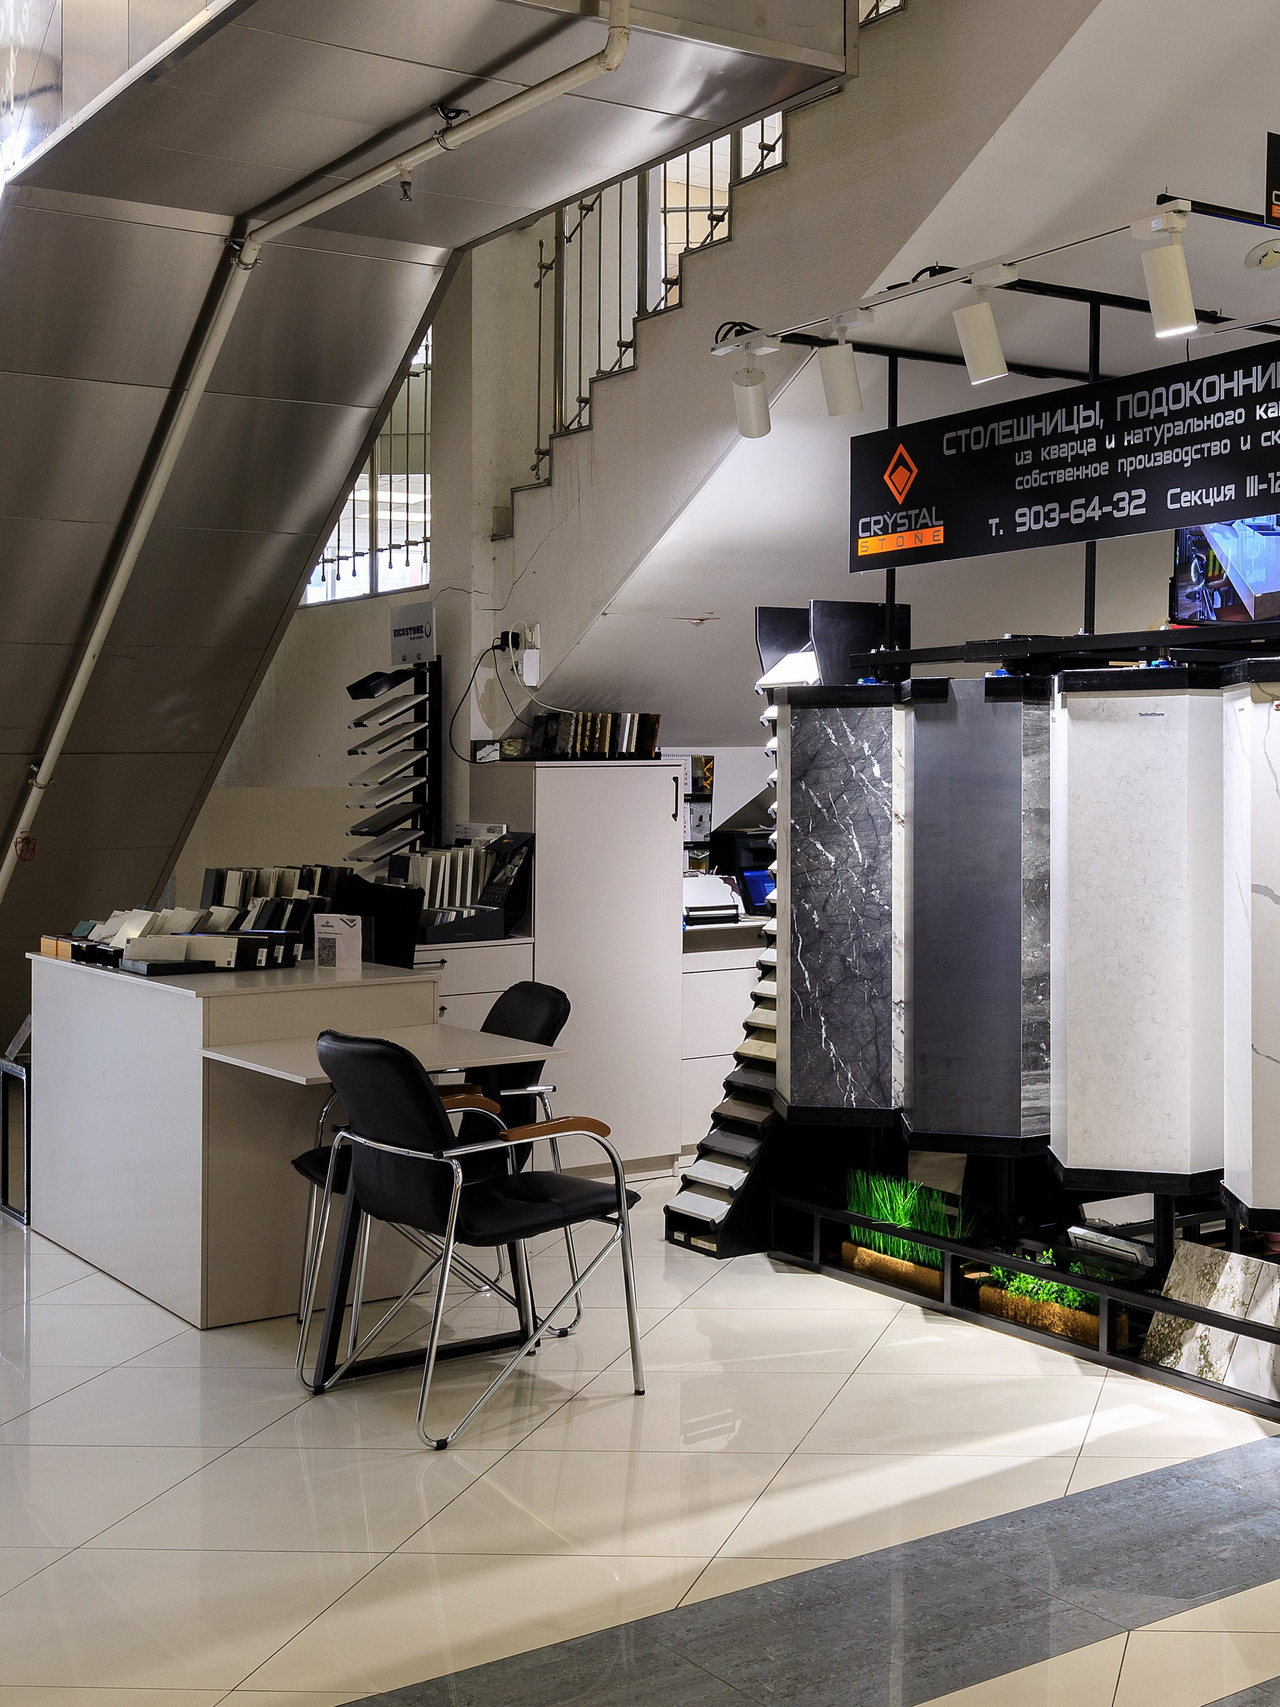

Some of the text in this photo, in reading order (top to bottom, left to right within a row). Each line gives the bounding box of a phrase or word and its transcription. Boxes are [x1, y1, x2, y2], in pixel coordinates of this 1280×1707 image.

[943, 401, 1104, 456] СТОЛЕШНИЦЫ,
[1015, 448, 1033, 466] из
[1041, 437, 1097, 463] кварца
[1105, 433, 1116, 450] и
[1123, 408, 1246, 446] натурального
[1015, 460, 1110, 490] собственное
[1118, 439, 1231, 477] производство
[1241, 434, 1251, 451] и
[857, 506, 944, 538] CRYSTAL
[1014, 488, 1147, 533] 903-64-32
[1166, 482, 1236, 509] Секция
[861, 529, 941, 553] STONE
